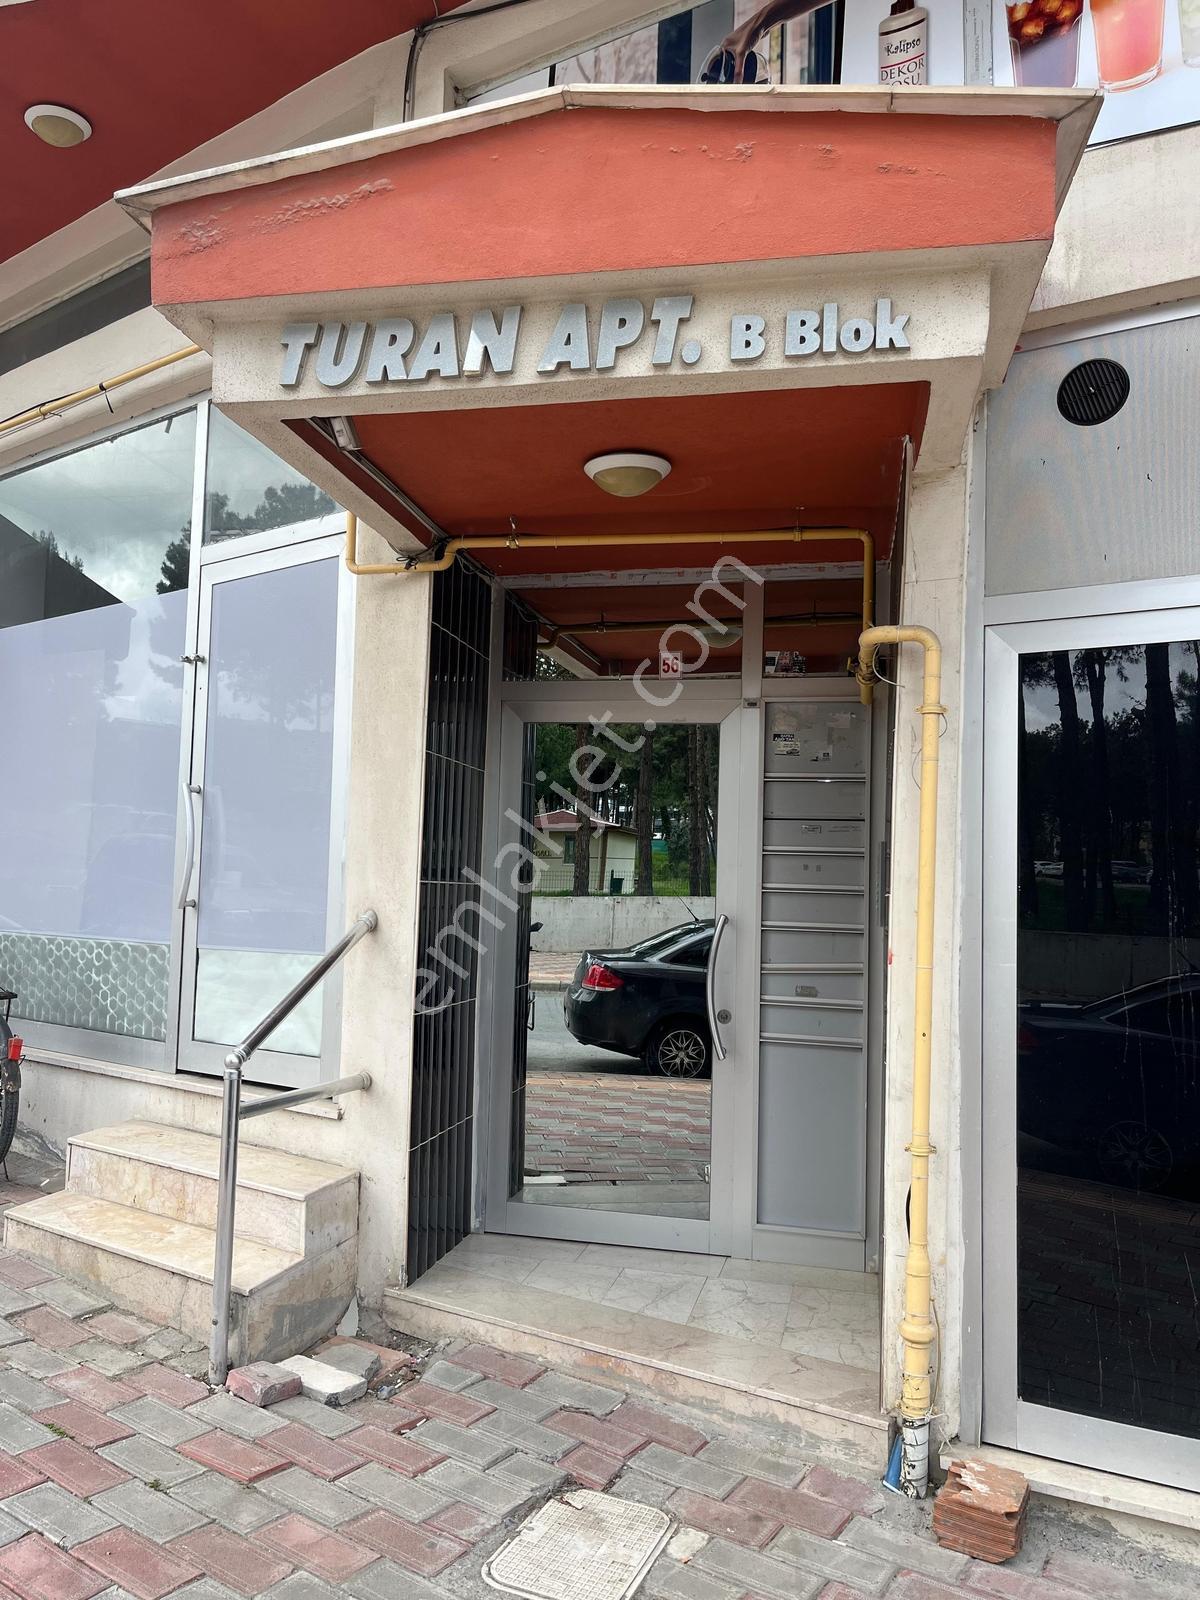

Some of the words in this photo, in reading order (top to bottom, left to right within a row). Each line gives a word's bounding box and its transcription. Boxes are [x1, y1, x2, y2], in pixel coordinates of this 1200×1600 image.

[884, 38, 921, 56] Kalipso
[881, 58, 925, 81] DEKOR
[885, 73, 922, 86] SU
[279, 305, 524, 388] TURAN
[536, 295, 701, 372] APT.
[730, 314, 767, 362] B
[784, 298, 911, 357] Blok
[662, 656, 679, 673] 56
